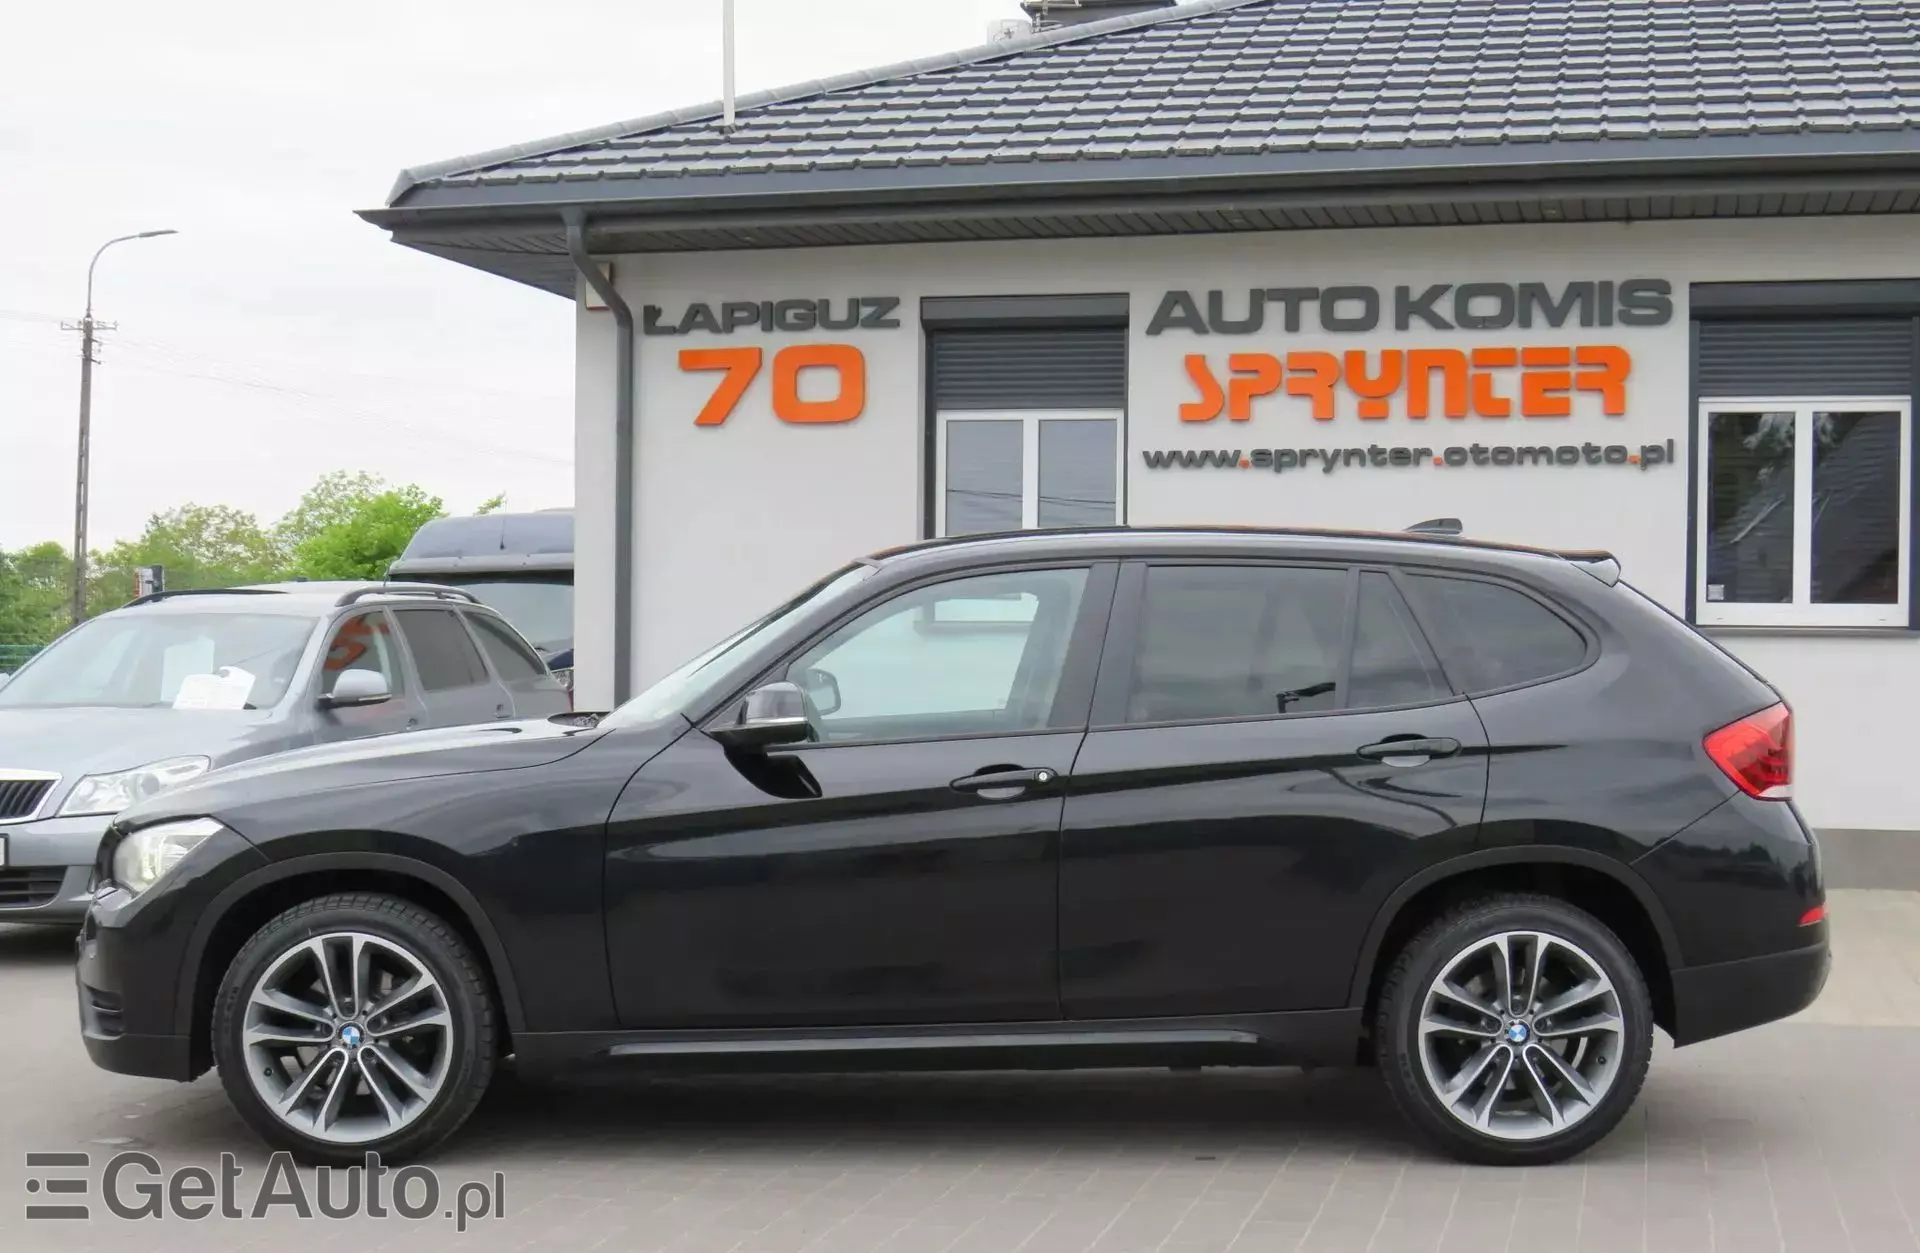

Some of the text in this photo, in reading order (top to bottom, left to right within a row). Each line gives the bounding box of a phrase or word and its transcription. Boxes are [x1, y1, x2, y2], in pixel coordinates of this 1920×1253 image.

[643, 297, 901, 335] ŁAPIGUZ
[1145, 279, 1674, 335] AUTO KOMIS
[679, 343, 866, 426] 70
[1179, 345, 1632, 422] SPRYNTER
[1143, 439, 1675, 473] www.sprynter.otomoto.pl
